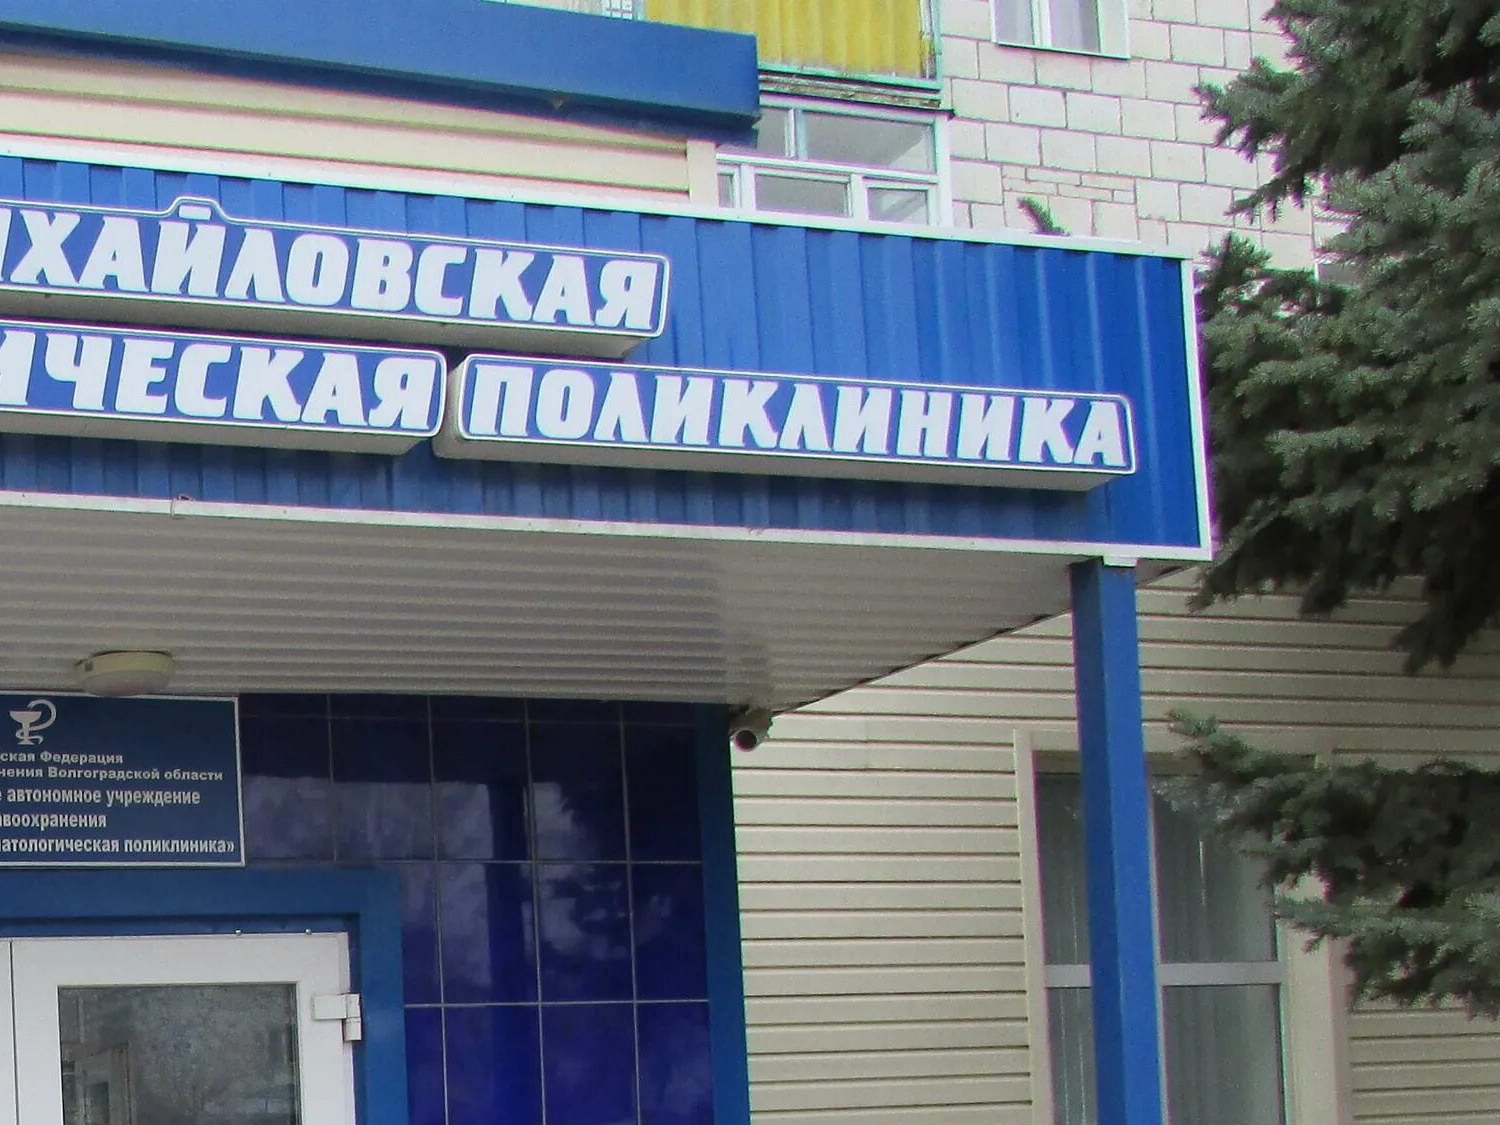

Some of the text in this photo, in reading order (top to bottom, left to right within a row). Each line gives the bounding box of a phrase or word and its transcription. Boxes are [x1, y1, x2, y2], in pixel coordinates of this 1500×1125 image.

[471, 361, 1127, 467] ПОЛИКЛИНИКА
[40, 751, 123, 765] Федерация
[48, 767, 160, 781] Волгоградской
[164, 768, 223, 781] области
[7, 787, 101, 803] автономное
[106, 789, 200, 807] учреждение
[124, 838, 235, 854] поликлиника»
